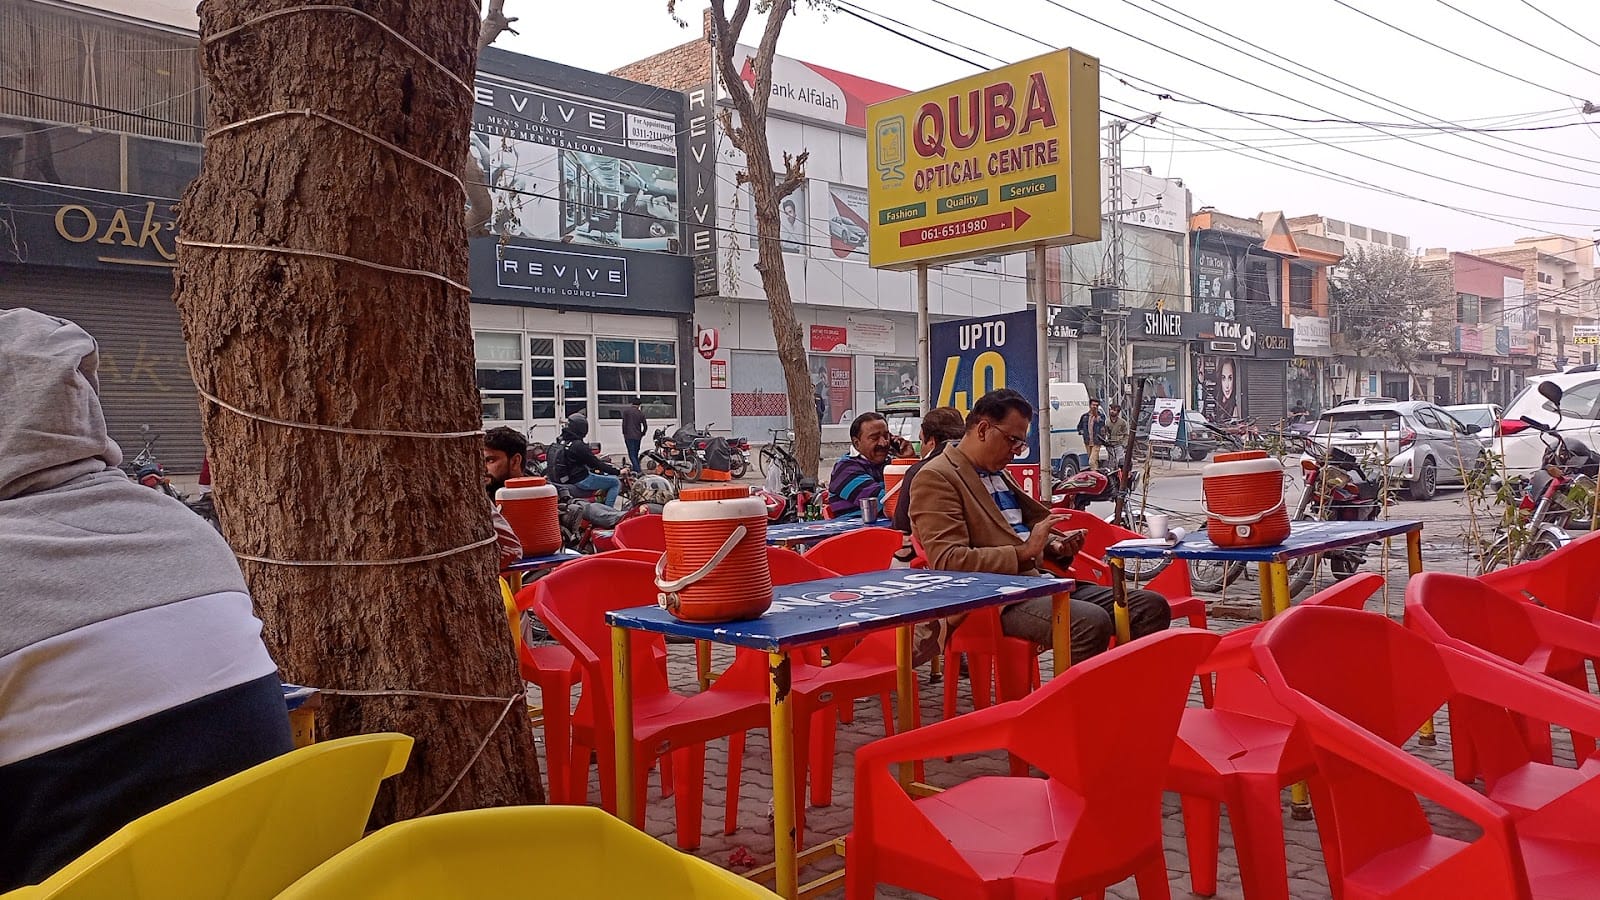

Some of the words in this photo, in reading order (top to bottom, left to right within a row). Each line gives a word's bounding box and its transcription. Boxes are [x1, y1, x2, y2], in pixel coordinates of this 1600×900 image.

[474, 86, 607, 131] EVIVE
[772, 81, 795, 100] ank
[798, 86, 840, 111] Alfalah
[487, 115, 520, 129] MEN'S
[525, 122, 566, 138] LOUNGE
[912, 71, 1058, 160] QUBA
[519, 131, 557, 146] MEN'S
[559, 137, 605, 154] SALOON
[913, 156, 984, 194] OPTICAL
[987, 138, 1059, 177] CENTRE
[1009, 180, 1046, 197] Service
[886, 207, 919, 221] Fashion
[945, 194, 979, 210] Quality
[54, 201, 177, 260] OAk'
[920, 219, 989, 241] 061-6511980
[503, 259, 621, 284] REVIVE
[561, 288, 597, 298] LOUNGE
[959, 319, 1007, 351] UPTO
[1144, 311, 1182, 336] SHINER
